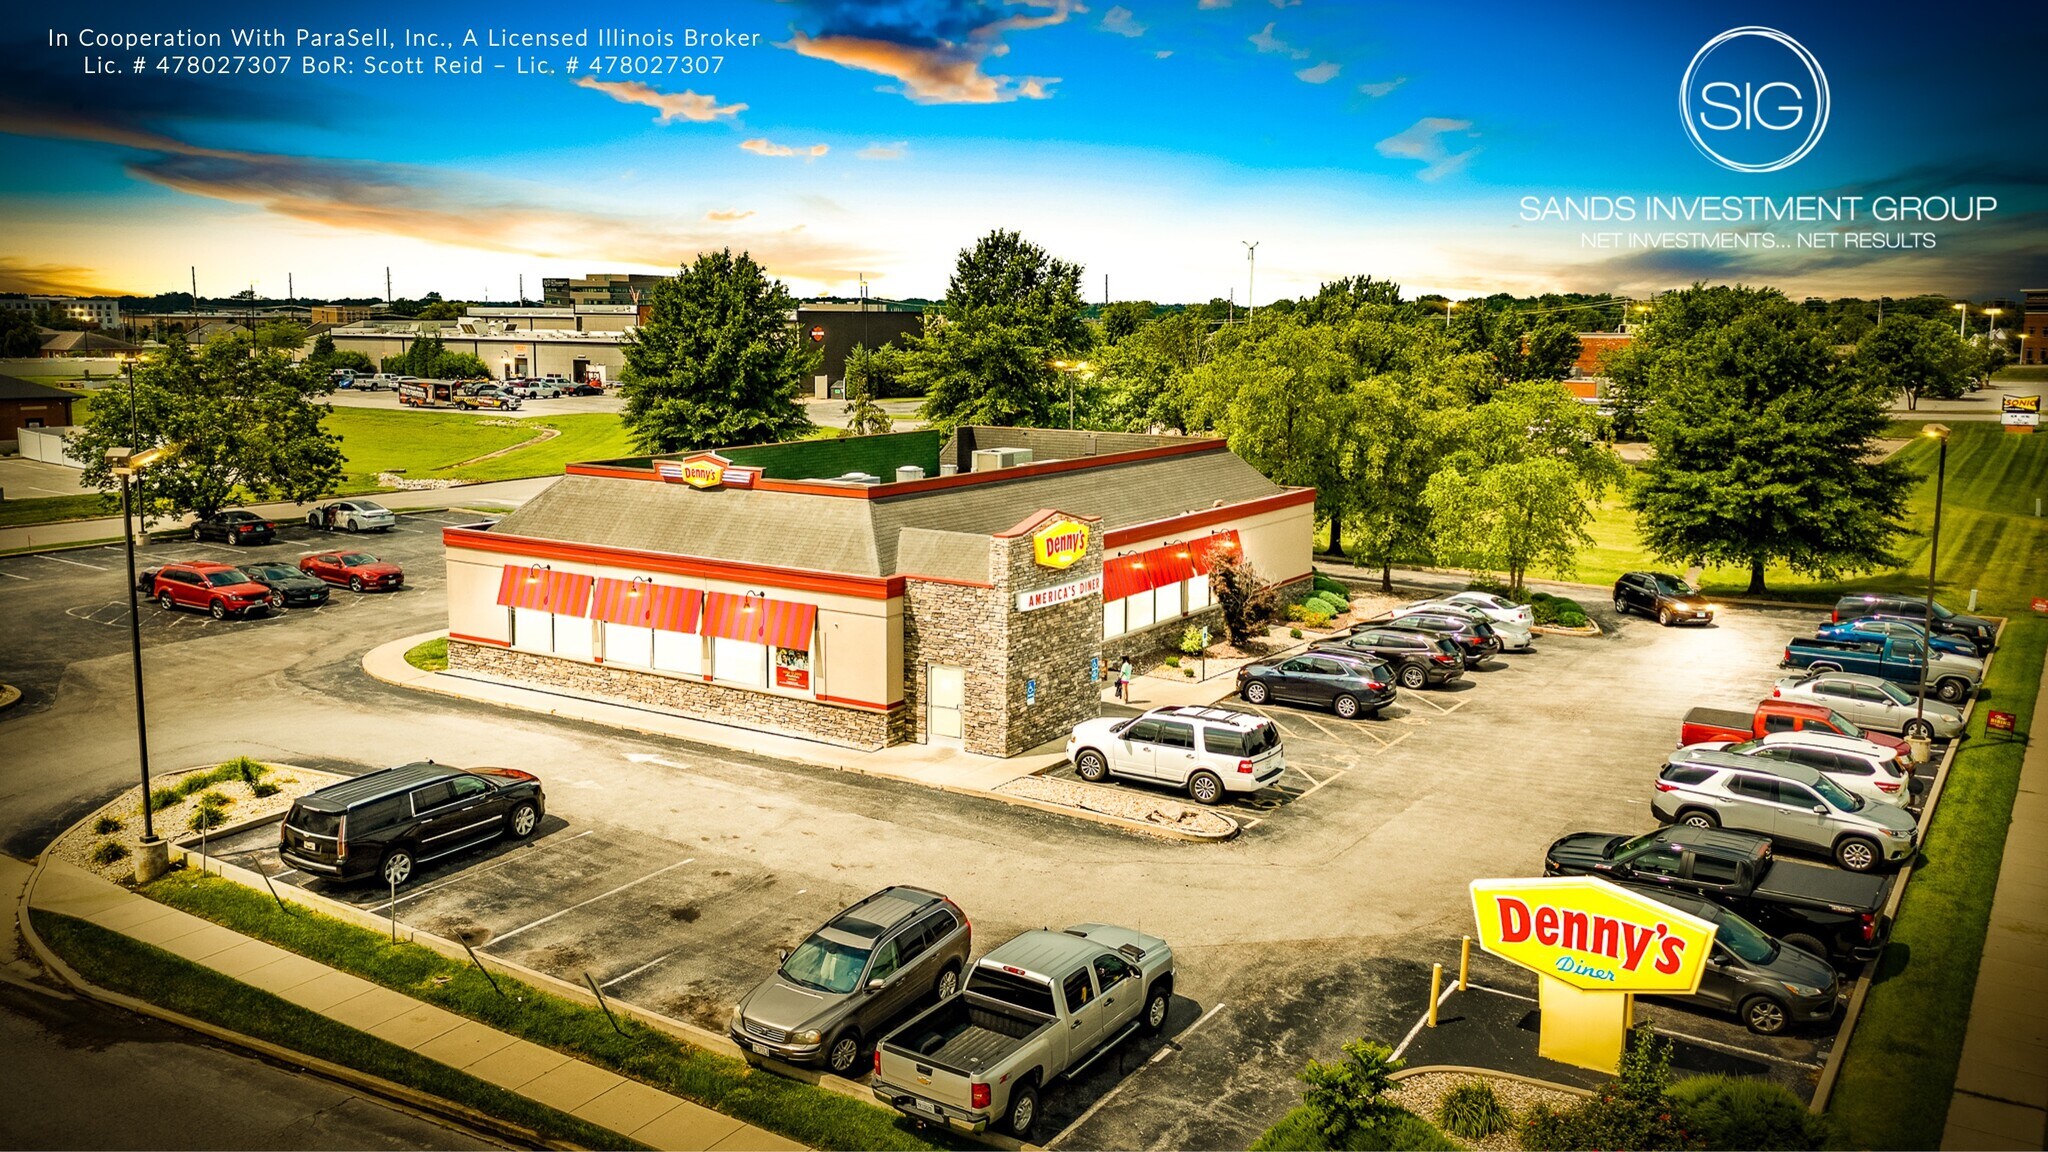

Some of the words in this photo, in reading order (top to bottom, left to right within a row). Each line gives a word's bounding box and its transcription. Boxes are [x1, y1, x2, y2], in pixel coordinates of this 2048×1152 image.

[2005, 399, 2036, 407] SONIC
[684, 467, 716, 481] Denny's
[1045, 529, 1085, 558] Denny's
[1028, 585, 1076, 607] AMERICA'S
[1079, 578, 1100, 595] DINER
[1496, 897, 1686, 975] Denny's
[1555, 956, 1615, 982] Diner
